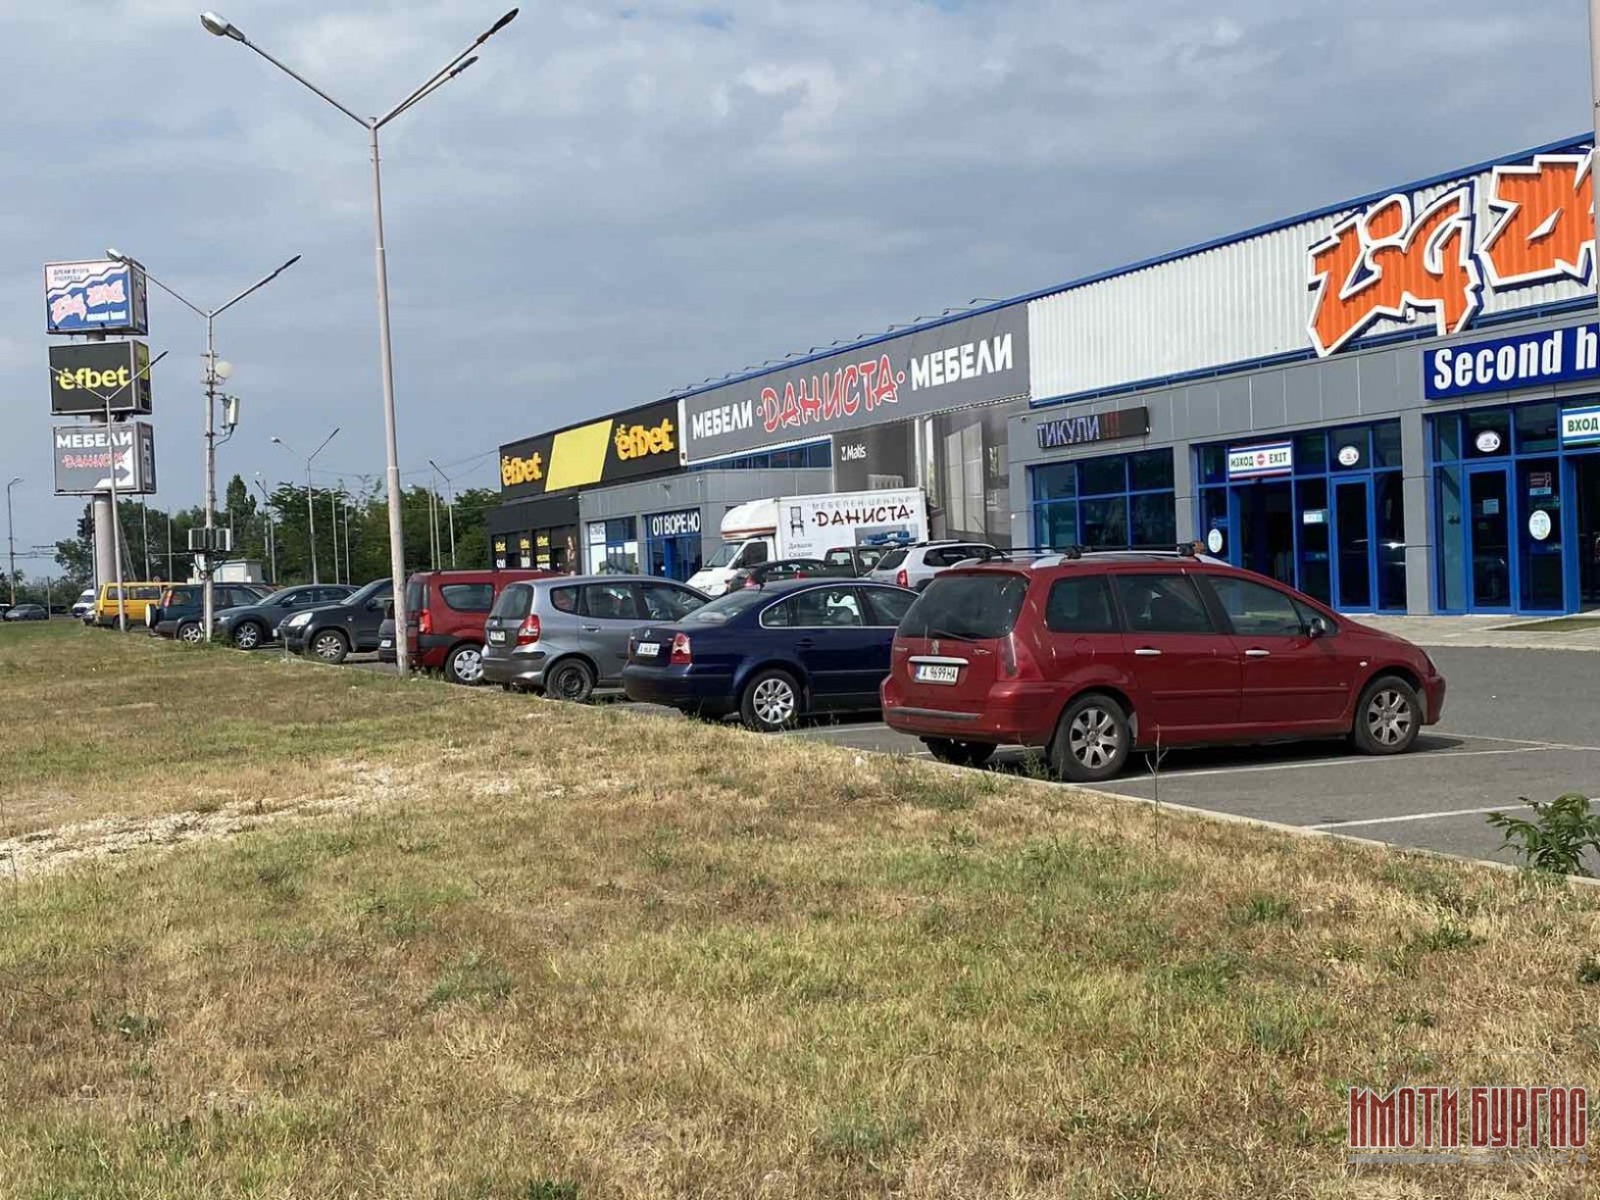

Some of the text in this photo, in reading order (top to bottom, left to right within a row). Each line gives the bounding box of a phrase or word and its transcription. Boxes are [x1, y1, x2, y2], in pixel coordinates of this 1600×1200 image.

[1434, 330, 1563, 390] Second
[57, 366, 129, 390] efbet
[692, 400, 753, 440] МЕБЕЛИ
[911, 333, 1013, 390] МЕБЕЛИ
[1567, 417, 1598, 432] ВХОД
[56, 431, 133, 448] МЕБЕЛИ
[615, 418, 674, 461] efbet
[1230, 452, 1287, 467] ИЗХОД EXIT
[652, 512, 700, 536] ОТВОРЕНО
